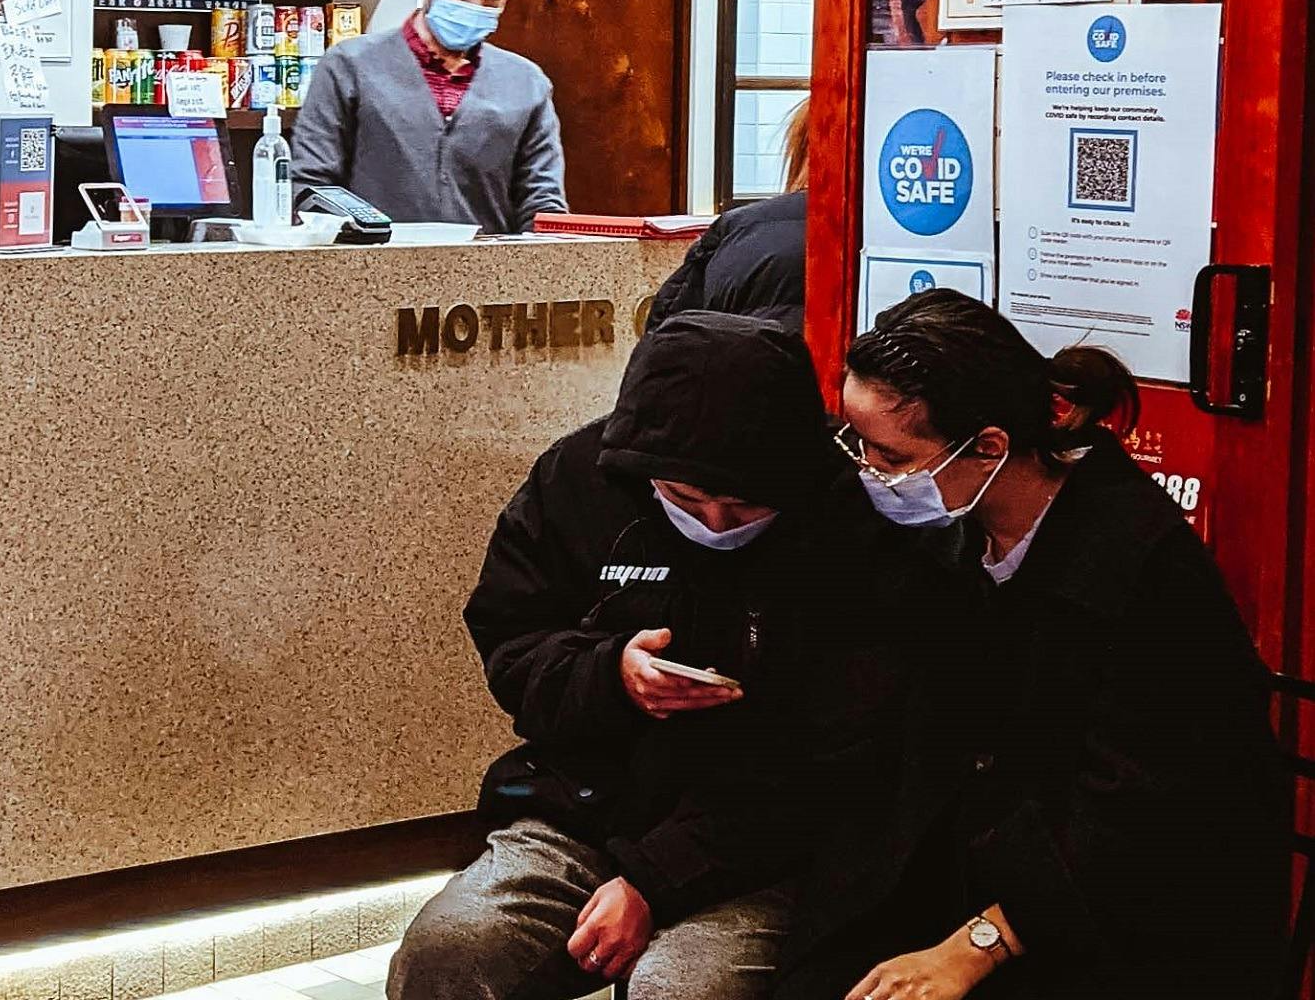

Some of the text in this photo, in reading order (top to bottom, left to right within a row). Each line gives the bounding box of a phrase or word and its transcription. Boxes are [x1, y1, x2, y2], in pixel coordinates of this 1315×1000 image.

[1095, 40, 1117, 49] SAFE
[1046, 71, 1166, 83] Please check in before
[1046, 84, 1166, 97] entering our premises.
[1070, 104, 1093, 113] helping
[1094, 105, 1109, 114] keep
[1122, 106, 1158, 115] community
[1087, 114, 1116, 122] recording
[900, 145, 933, 156] WE'RE
[889, 156, 962, 181] COVID
[896, 181, 955, 204] SAFE
[397, 300, 614, 356] MOTHER
